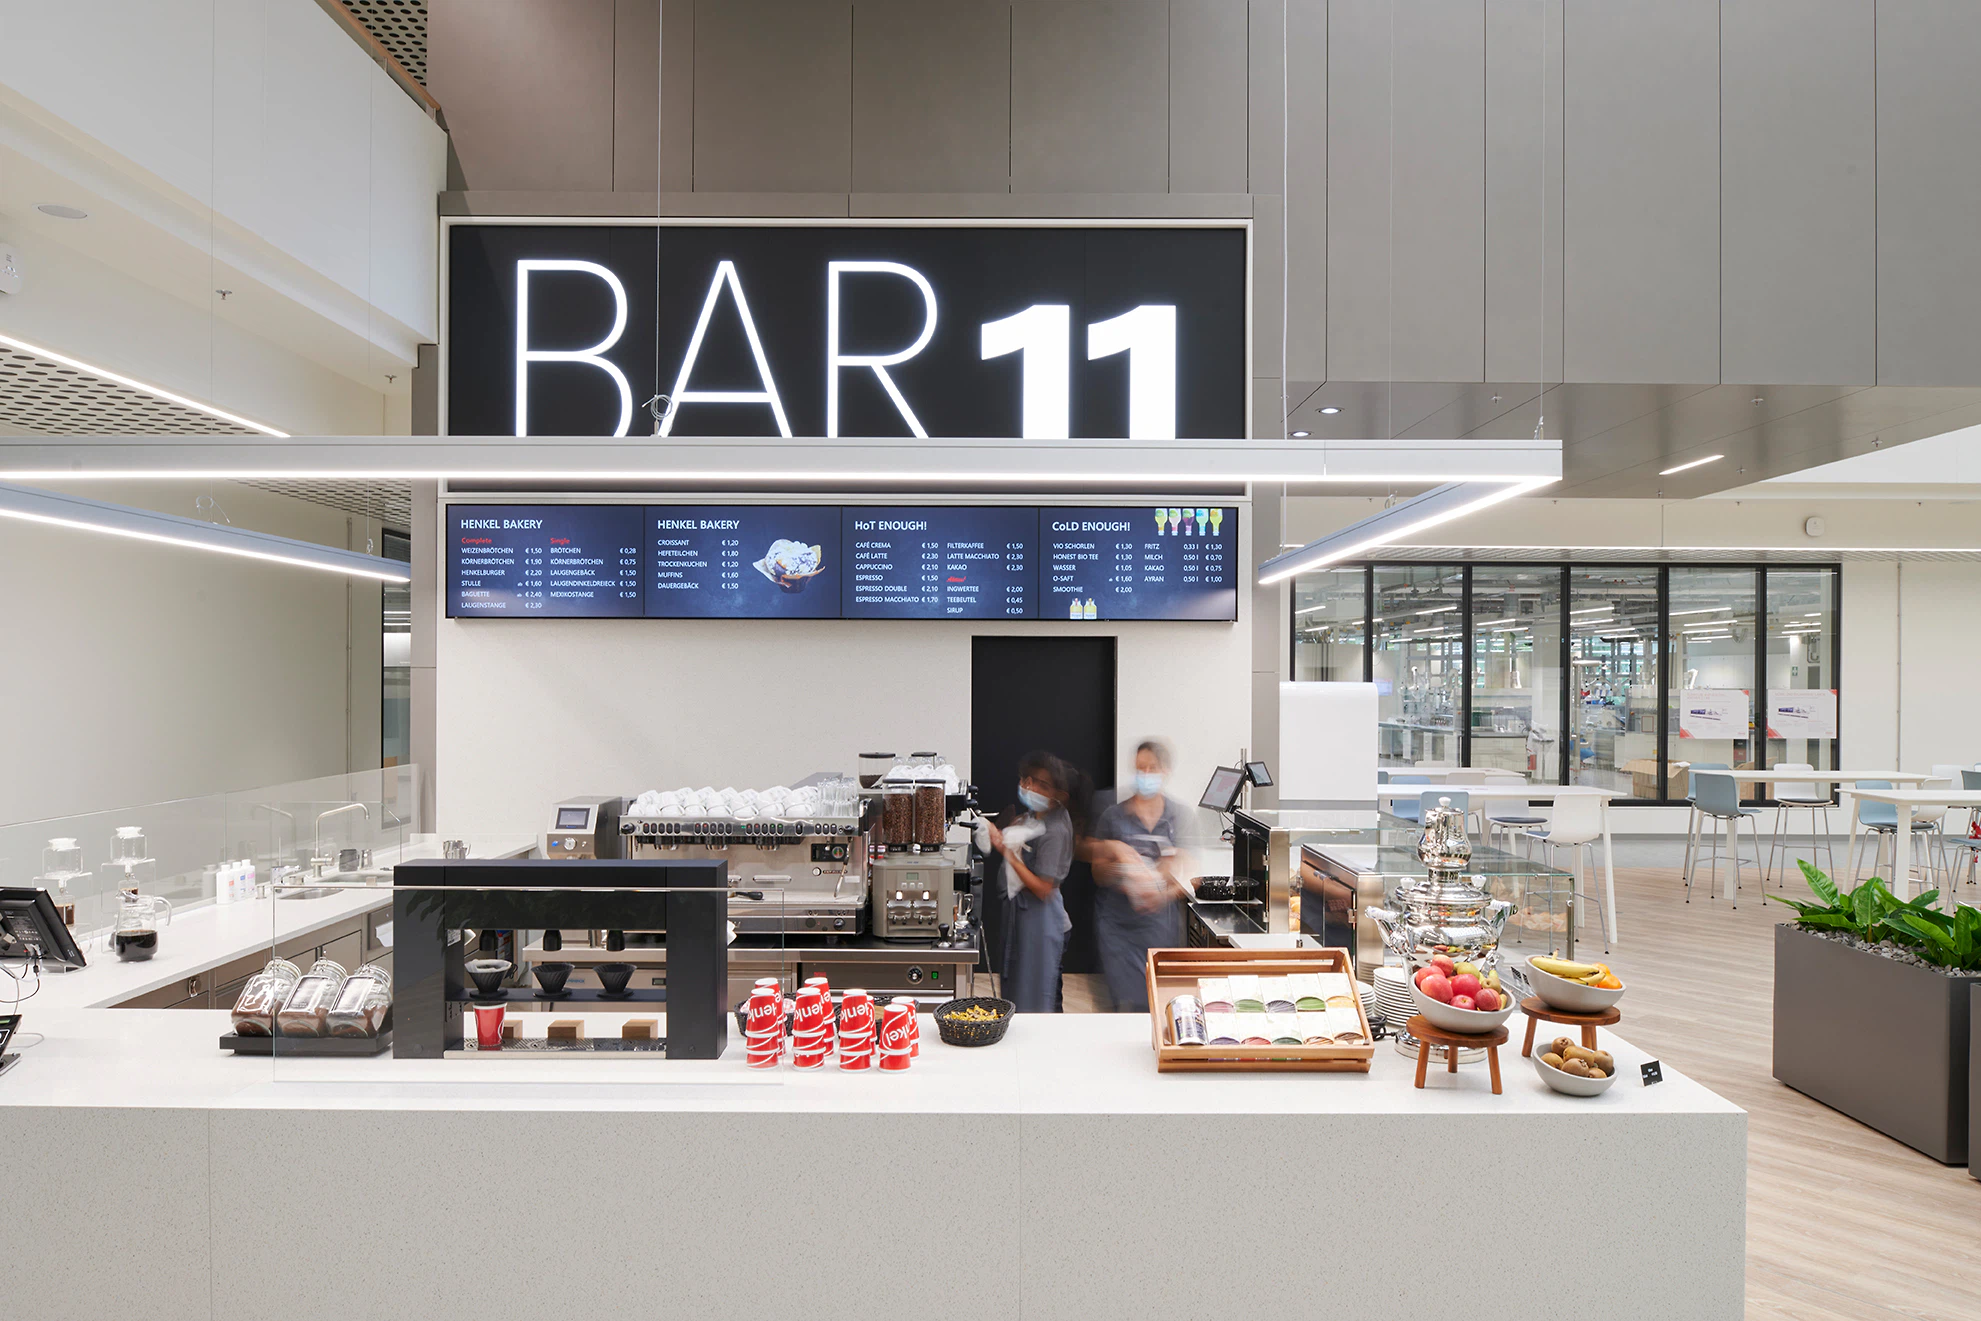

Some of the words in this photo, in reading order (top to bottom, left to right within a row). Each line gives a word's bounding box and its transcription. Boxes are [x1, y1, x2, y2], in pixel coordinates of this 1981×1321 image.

[514, 258, 938, 438] BAR
[980, 303, 1178, 440] 11
[461, 519, 500, 529] HENKEL
[503, 519, 542, 529] BAKERY
[657, 520, 697, 530] HENKEL
[700, 520, 739, 530] BAKERY
[855, 521, 876, 530] HoT
[879, 521, 927, 530] ENOUGH!
[1052, 522, 1079, 531] CoLD
[1082, 522, 1130, 531] ENOUGH!
